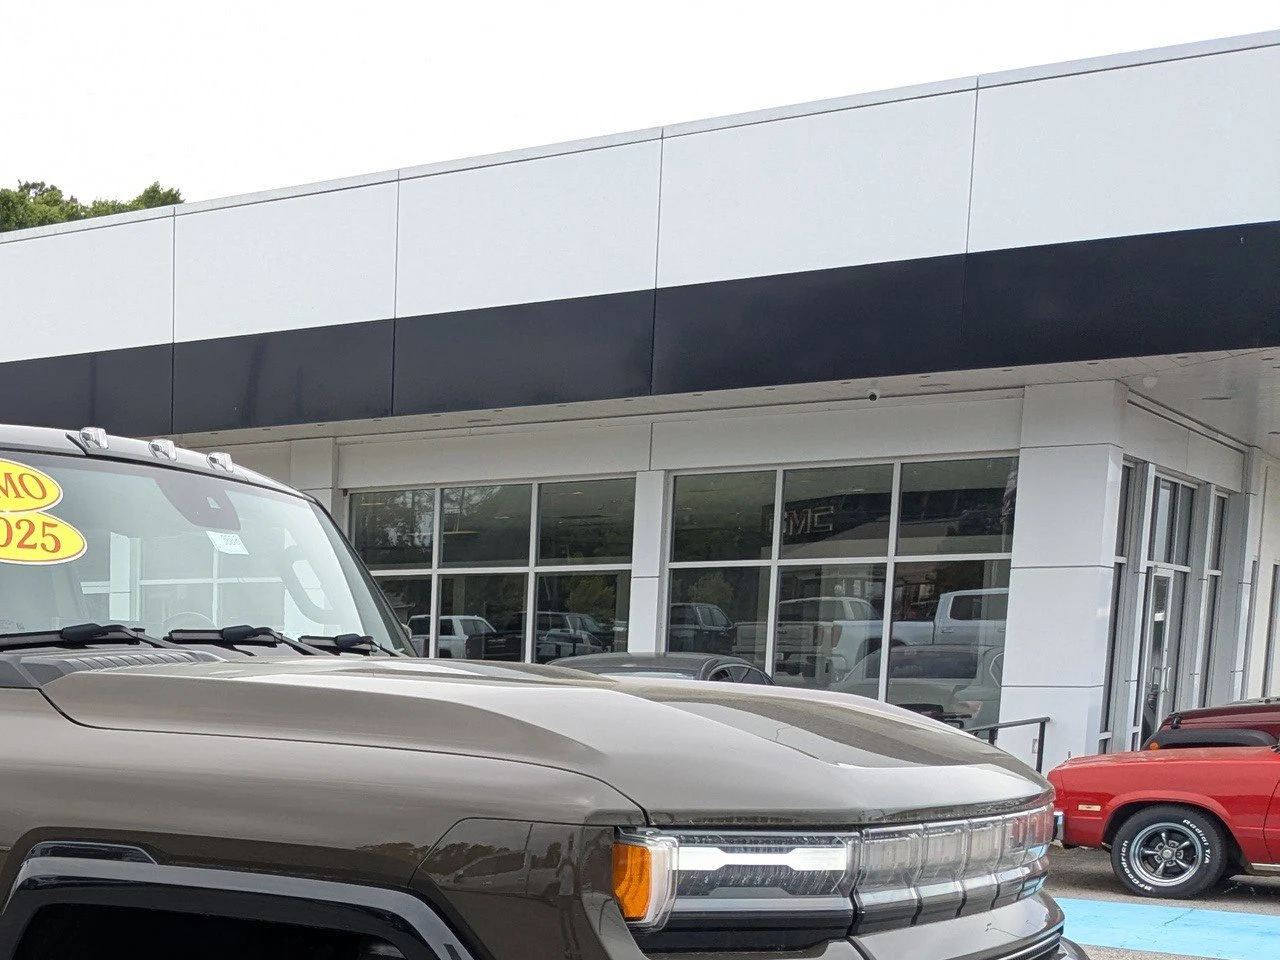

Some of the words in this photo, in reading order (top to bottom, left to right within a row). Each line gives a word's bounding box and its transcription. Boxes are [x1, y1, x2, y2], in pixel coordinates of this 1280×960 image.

[768, 505, 834, 536] MC
[1182, 819, 1209, 846] Radial
[1120, 840, 1154, 891] BFGoodrich
